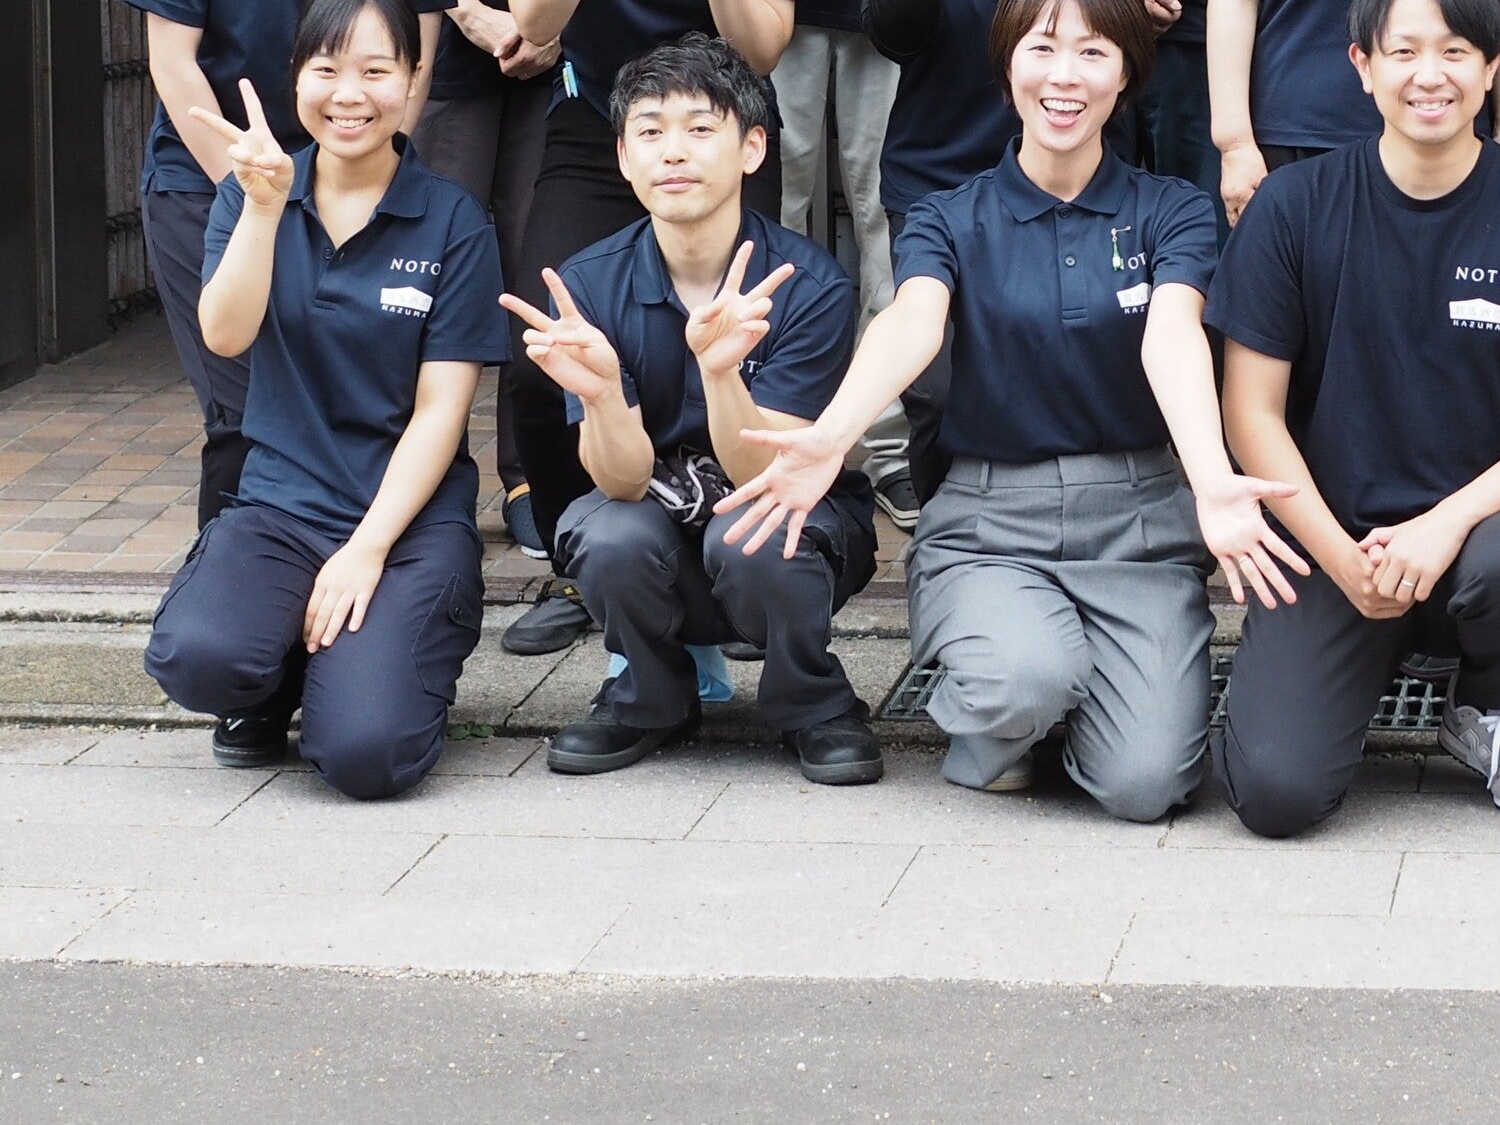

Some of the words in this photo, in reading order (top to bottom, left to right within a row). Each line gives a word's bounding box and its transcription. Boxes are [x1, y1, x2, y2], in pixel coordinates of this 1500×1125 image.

[389, 257, 442, 276] NOTO
[381, 303, 428, 319] KAZUMA
[1124, 306, 1146, 315] KAZ
[1452, 319, 1500, 332] KAZUMA
